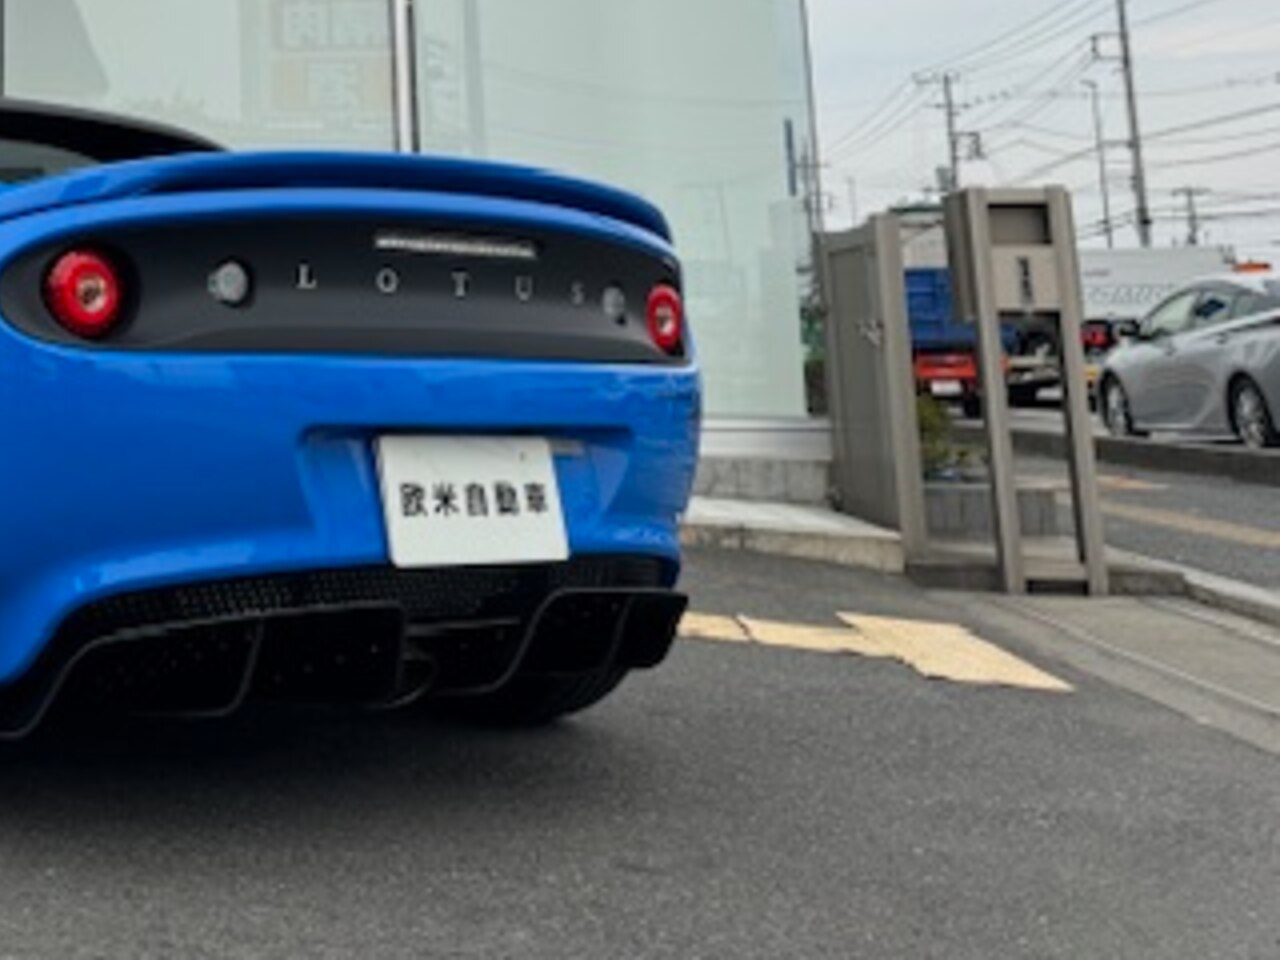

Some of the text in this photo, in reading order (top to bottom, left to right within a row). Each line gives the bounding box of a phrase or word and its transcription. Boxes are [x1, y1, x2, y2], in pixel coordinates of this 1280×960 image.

[296, 263, 586, 306] LOTUS
[399, 480, 549, 518] 欧米自動車
